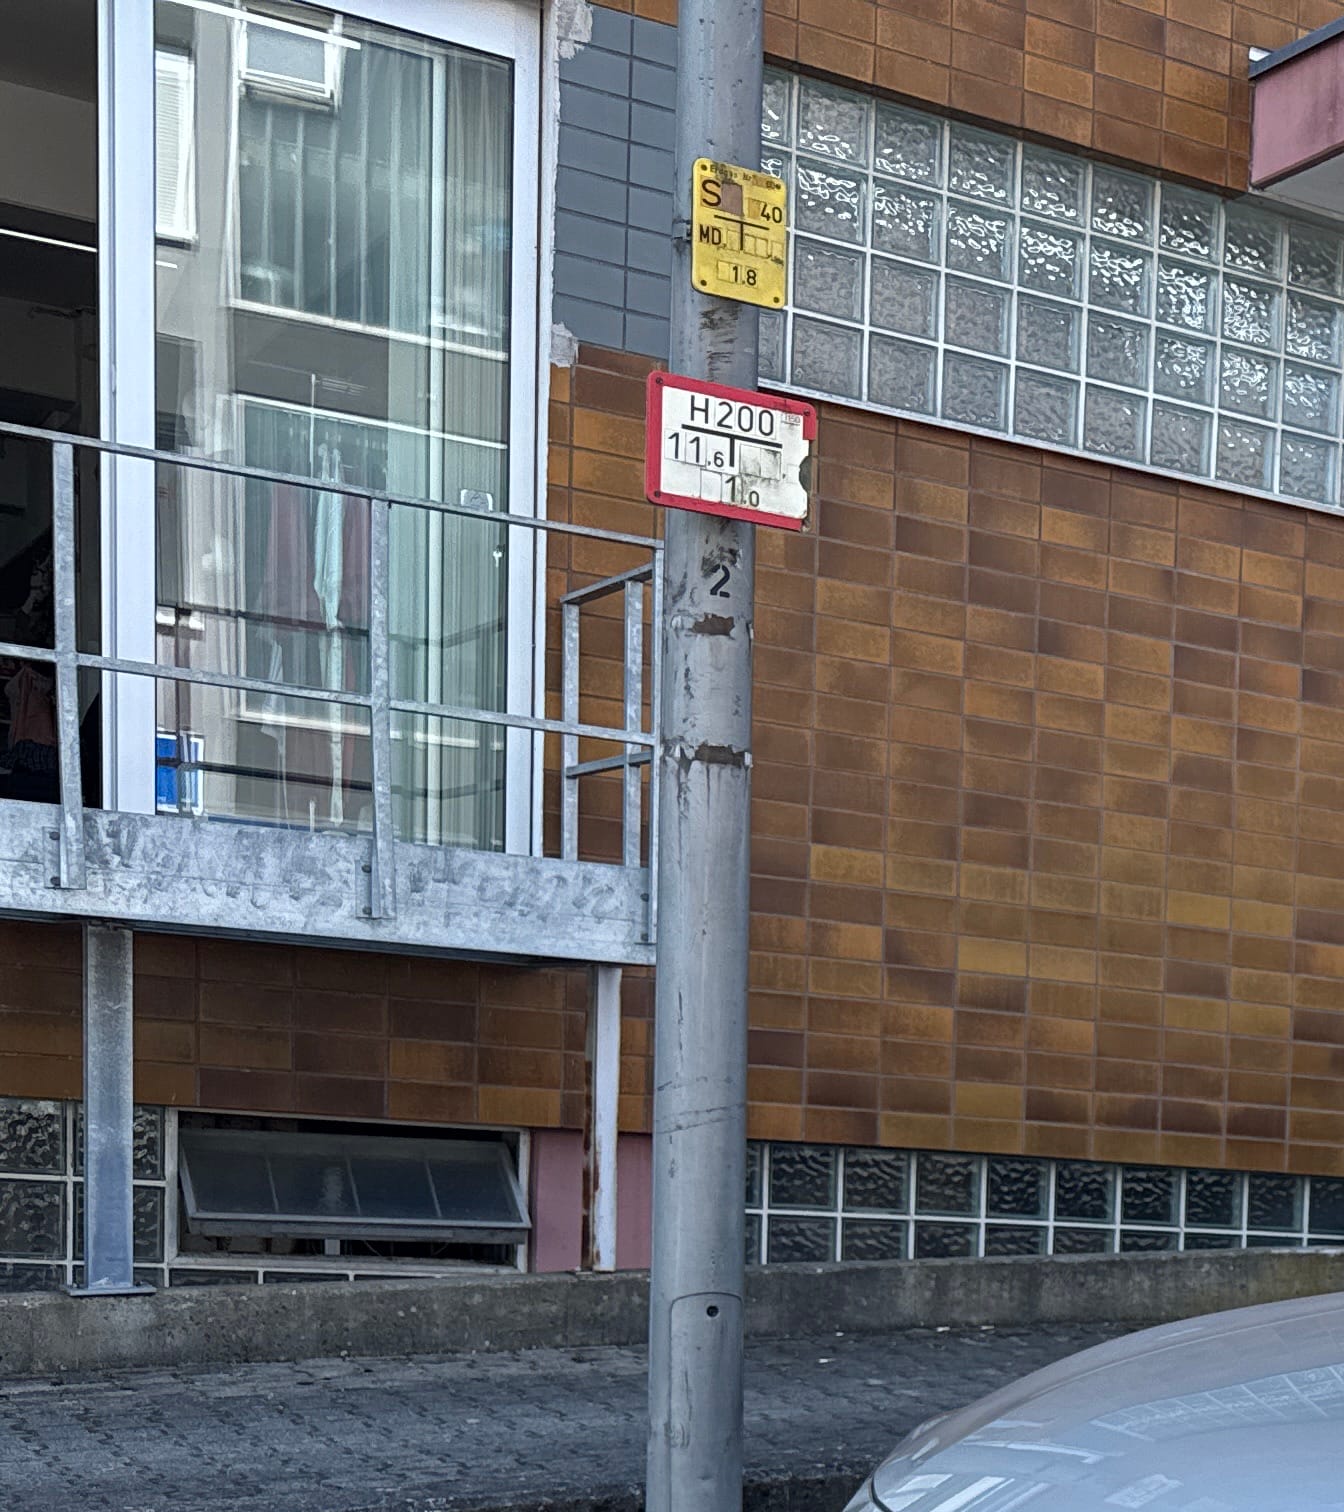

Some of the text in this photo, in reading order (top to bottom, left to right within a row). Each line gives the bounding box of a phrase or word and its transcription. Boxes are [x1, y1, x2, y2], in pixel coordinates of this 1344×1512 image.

[701, 179, 783, 224] S 40
[709, 564, 731, 598] 2
